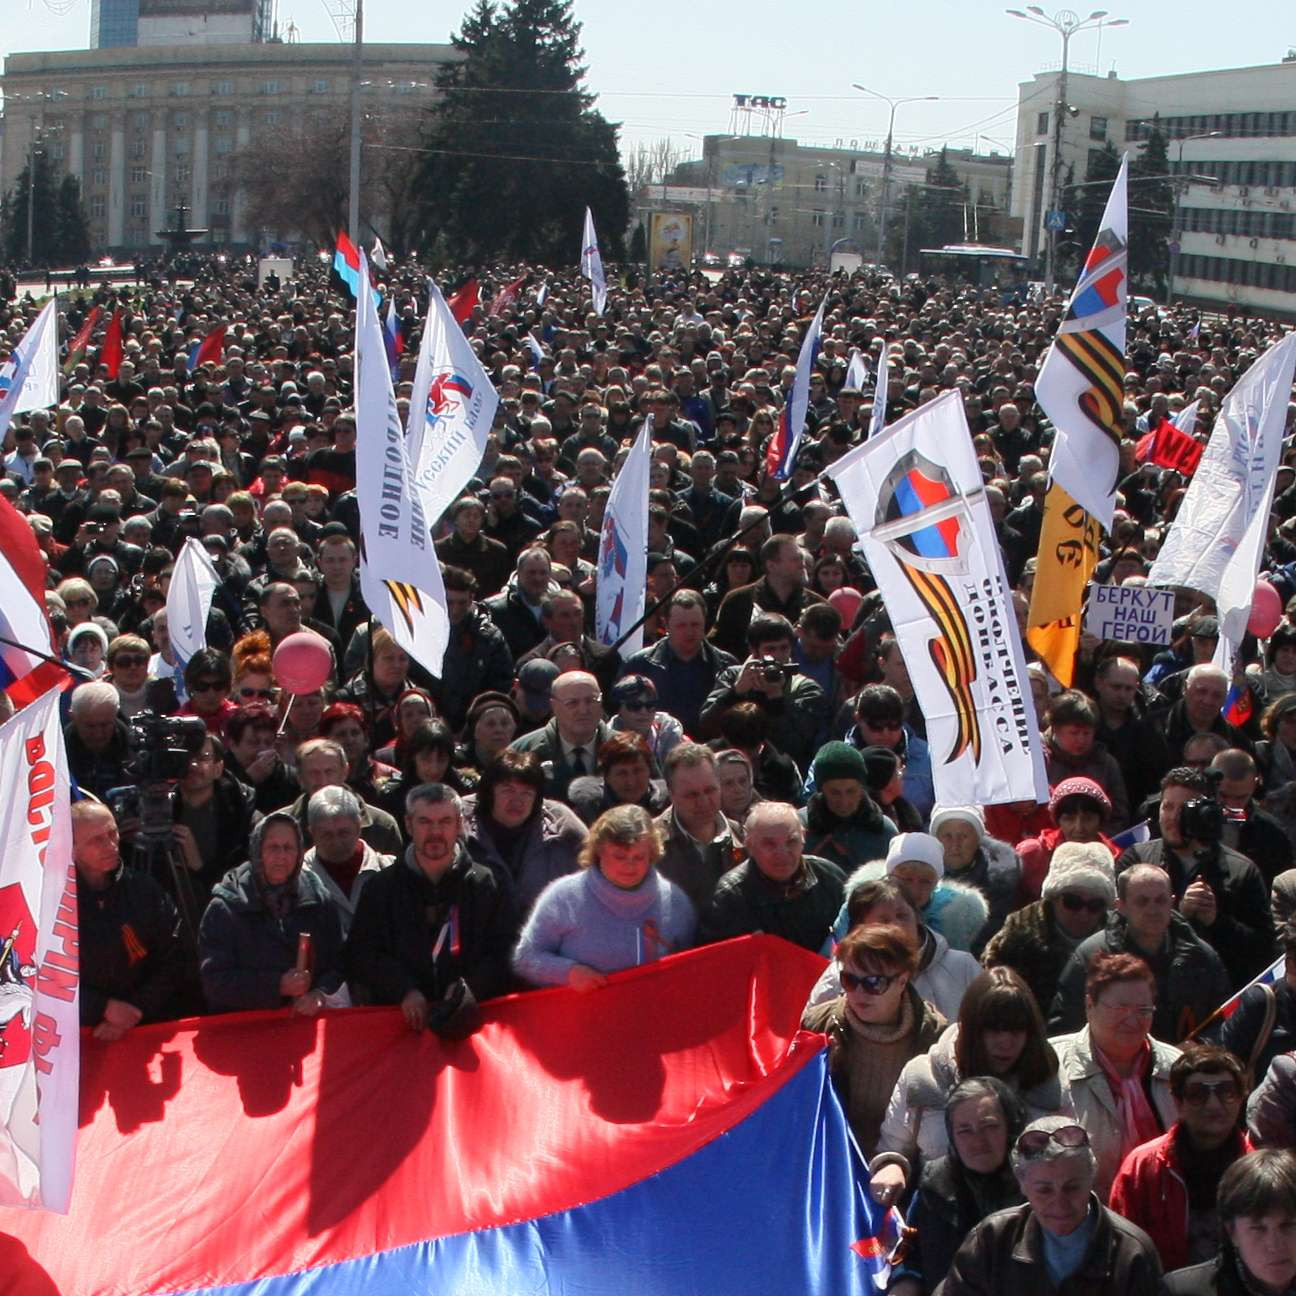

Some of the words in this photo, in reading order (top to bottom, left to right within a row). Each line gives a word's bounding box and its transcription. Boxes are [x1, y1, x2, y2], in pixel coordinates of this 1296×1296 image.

[1097, 586, 1174, 612] БЕРКУТ
[1114, 606, 1156, 624] НАШ
[1102, 621, 1167, 643] ГЕРОЙ
[965, 583, 1014, 755] ДОНБАССА
